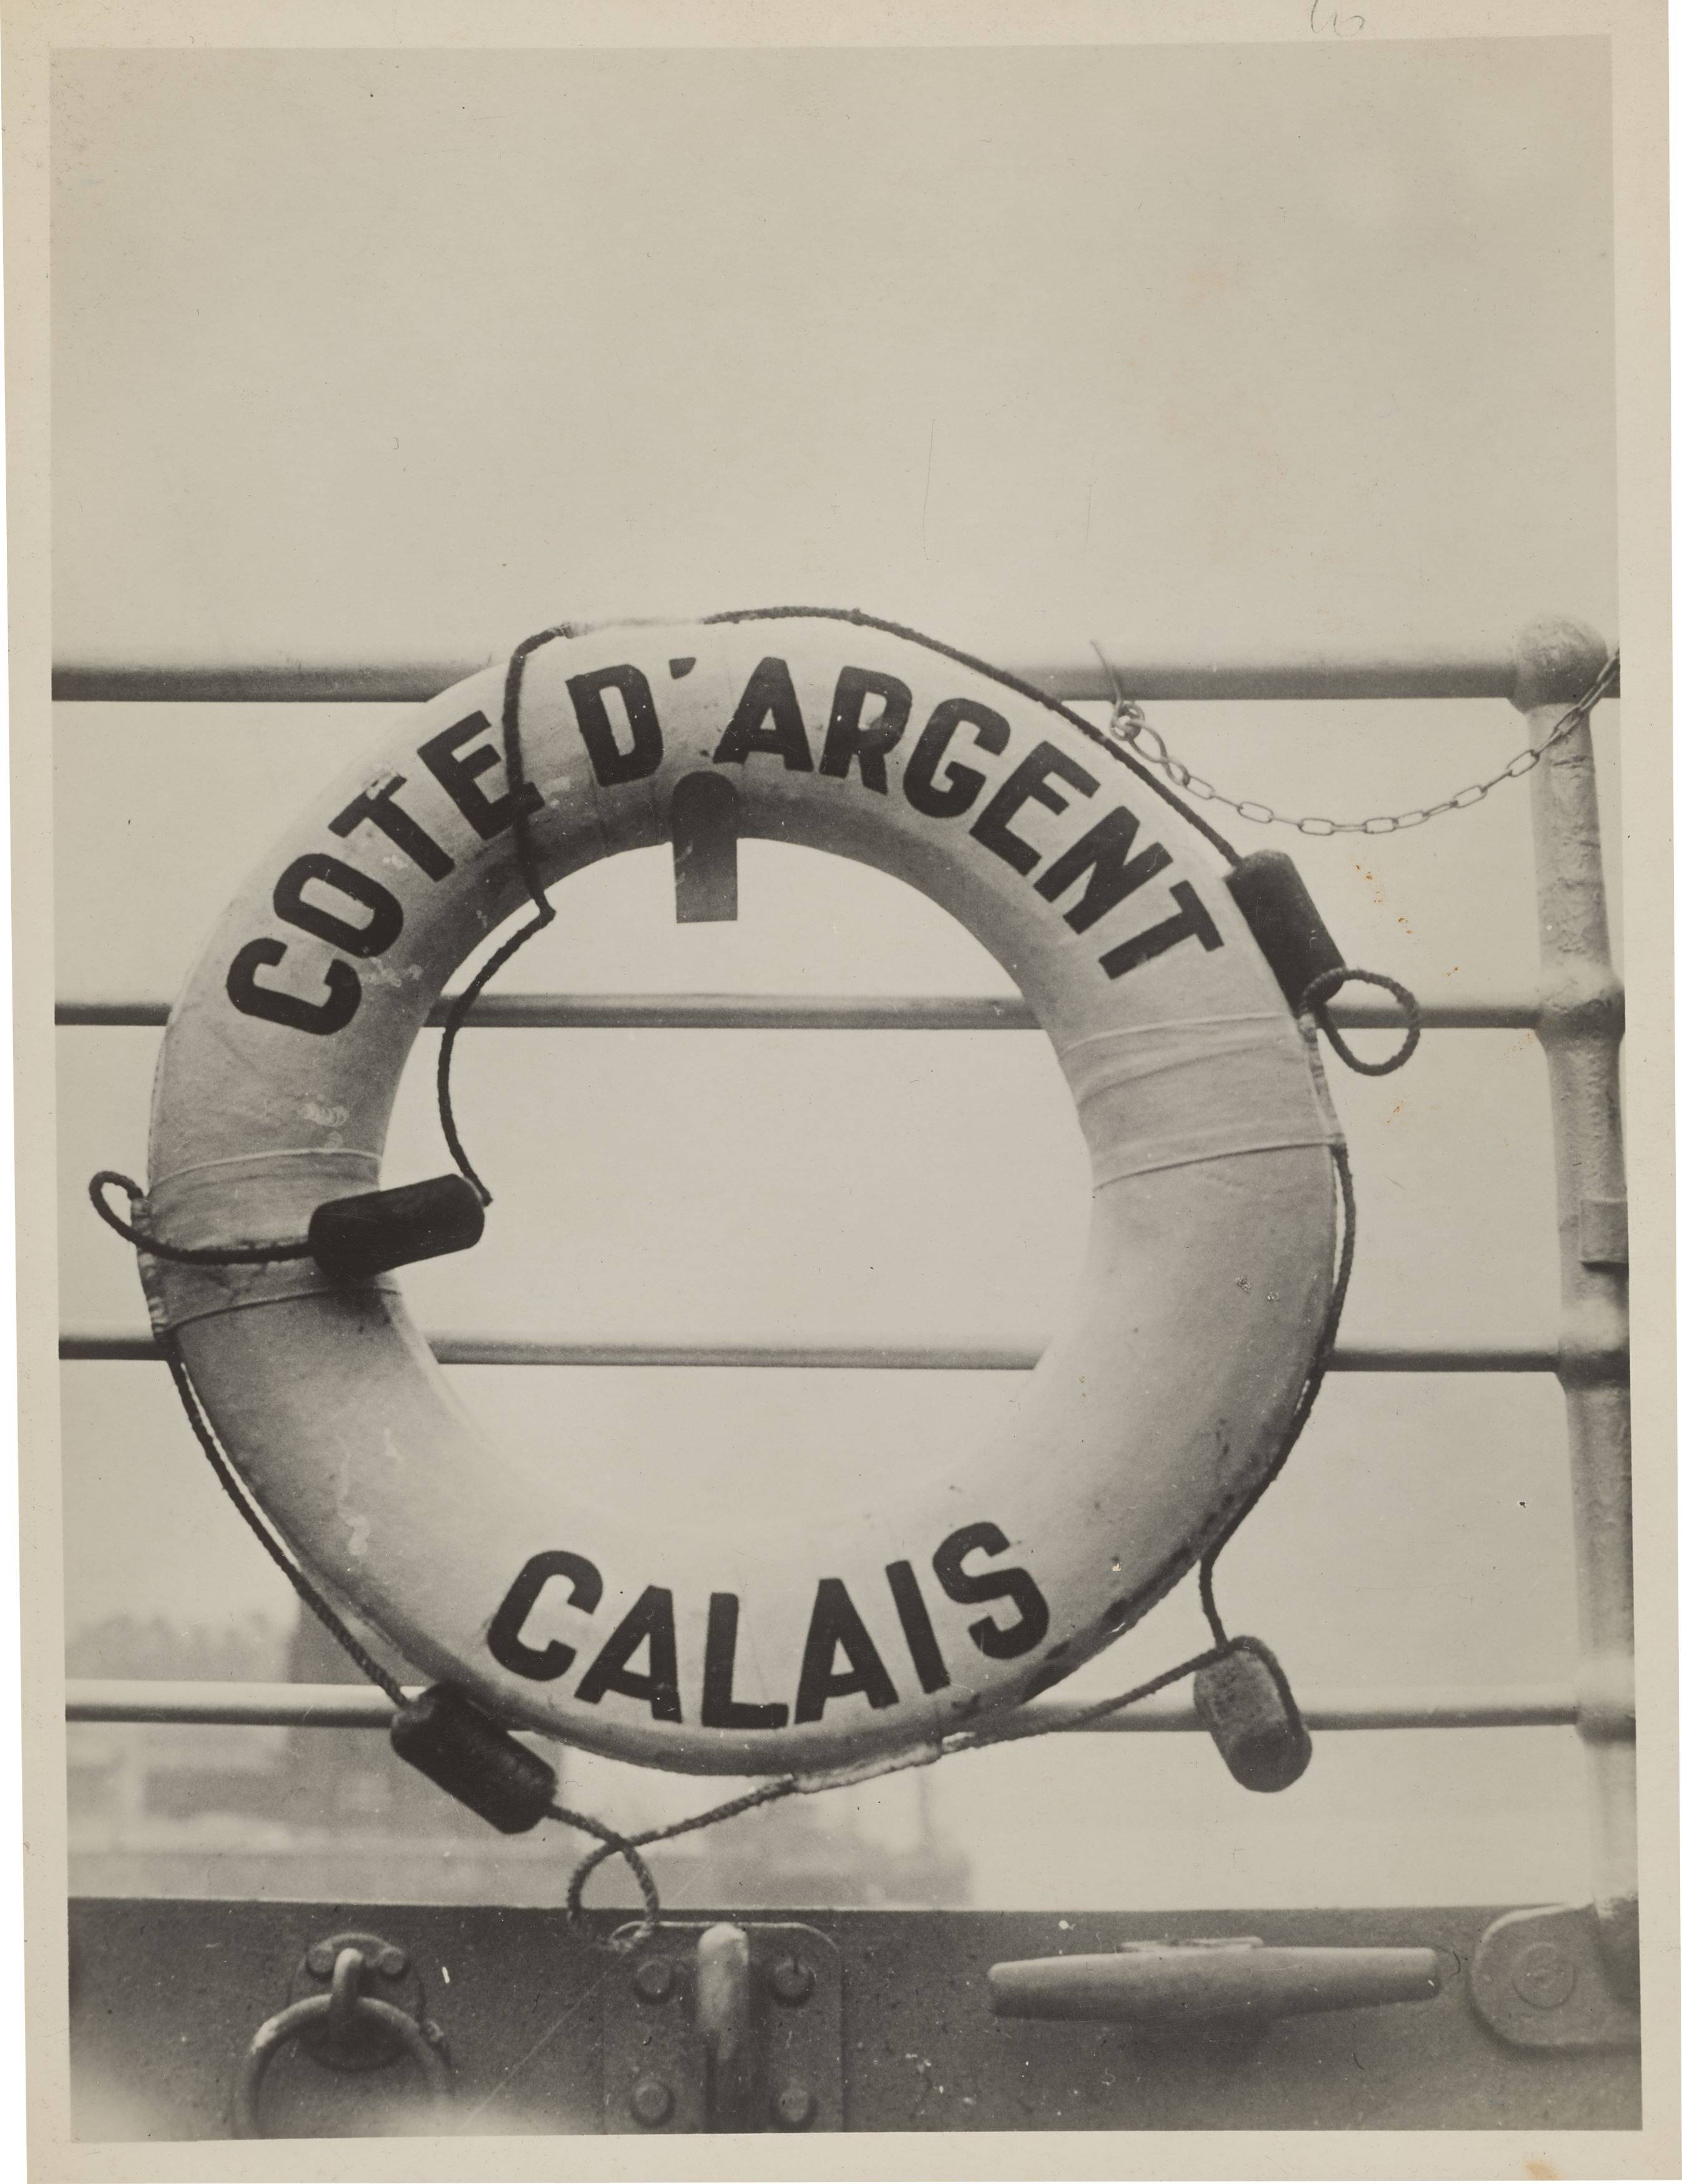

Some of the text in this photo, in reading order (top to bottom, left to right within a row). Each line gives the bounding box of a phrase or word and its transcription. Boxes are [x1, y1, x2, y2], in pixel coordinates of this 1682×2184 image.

[227, 656, 1224, 1036] COTE D'ARGENT
[487, 1521, 1050, 1728] CALAIS
